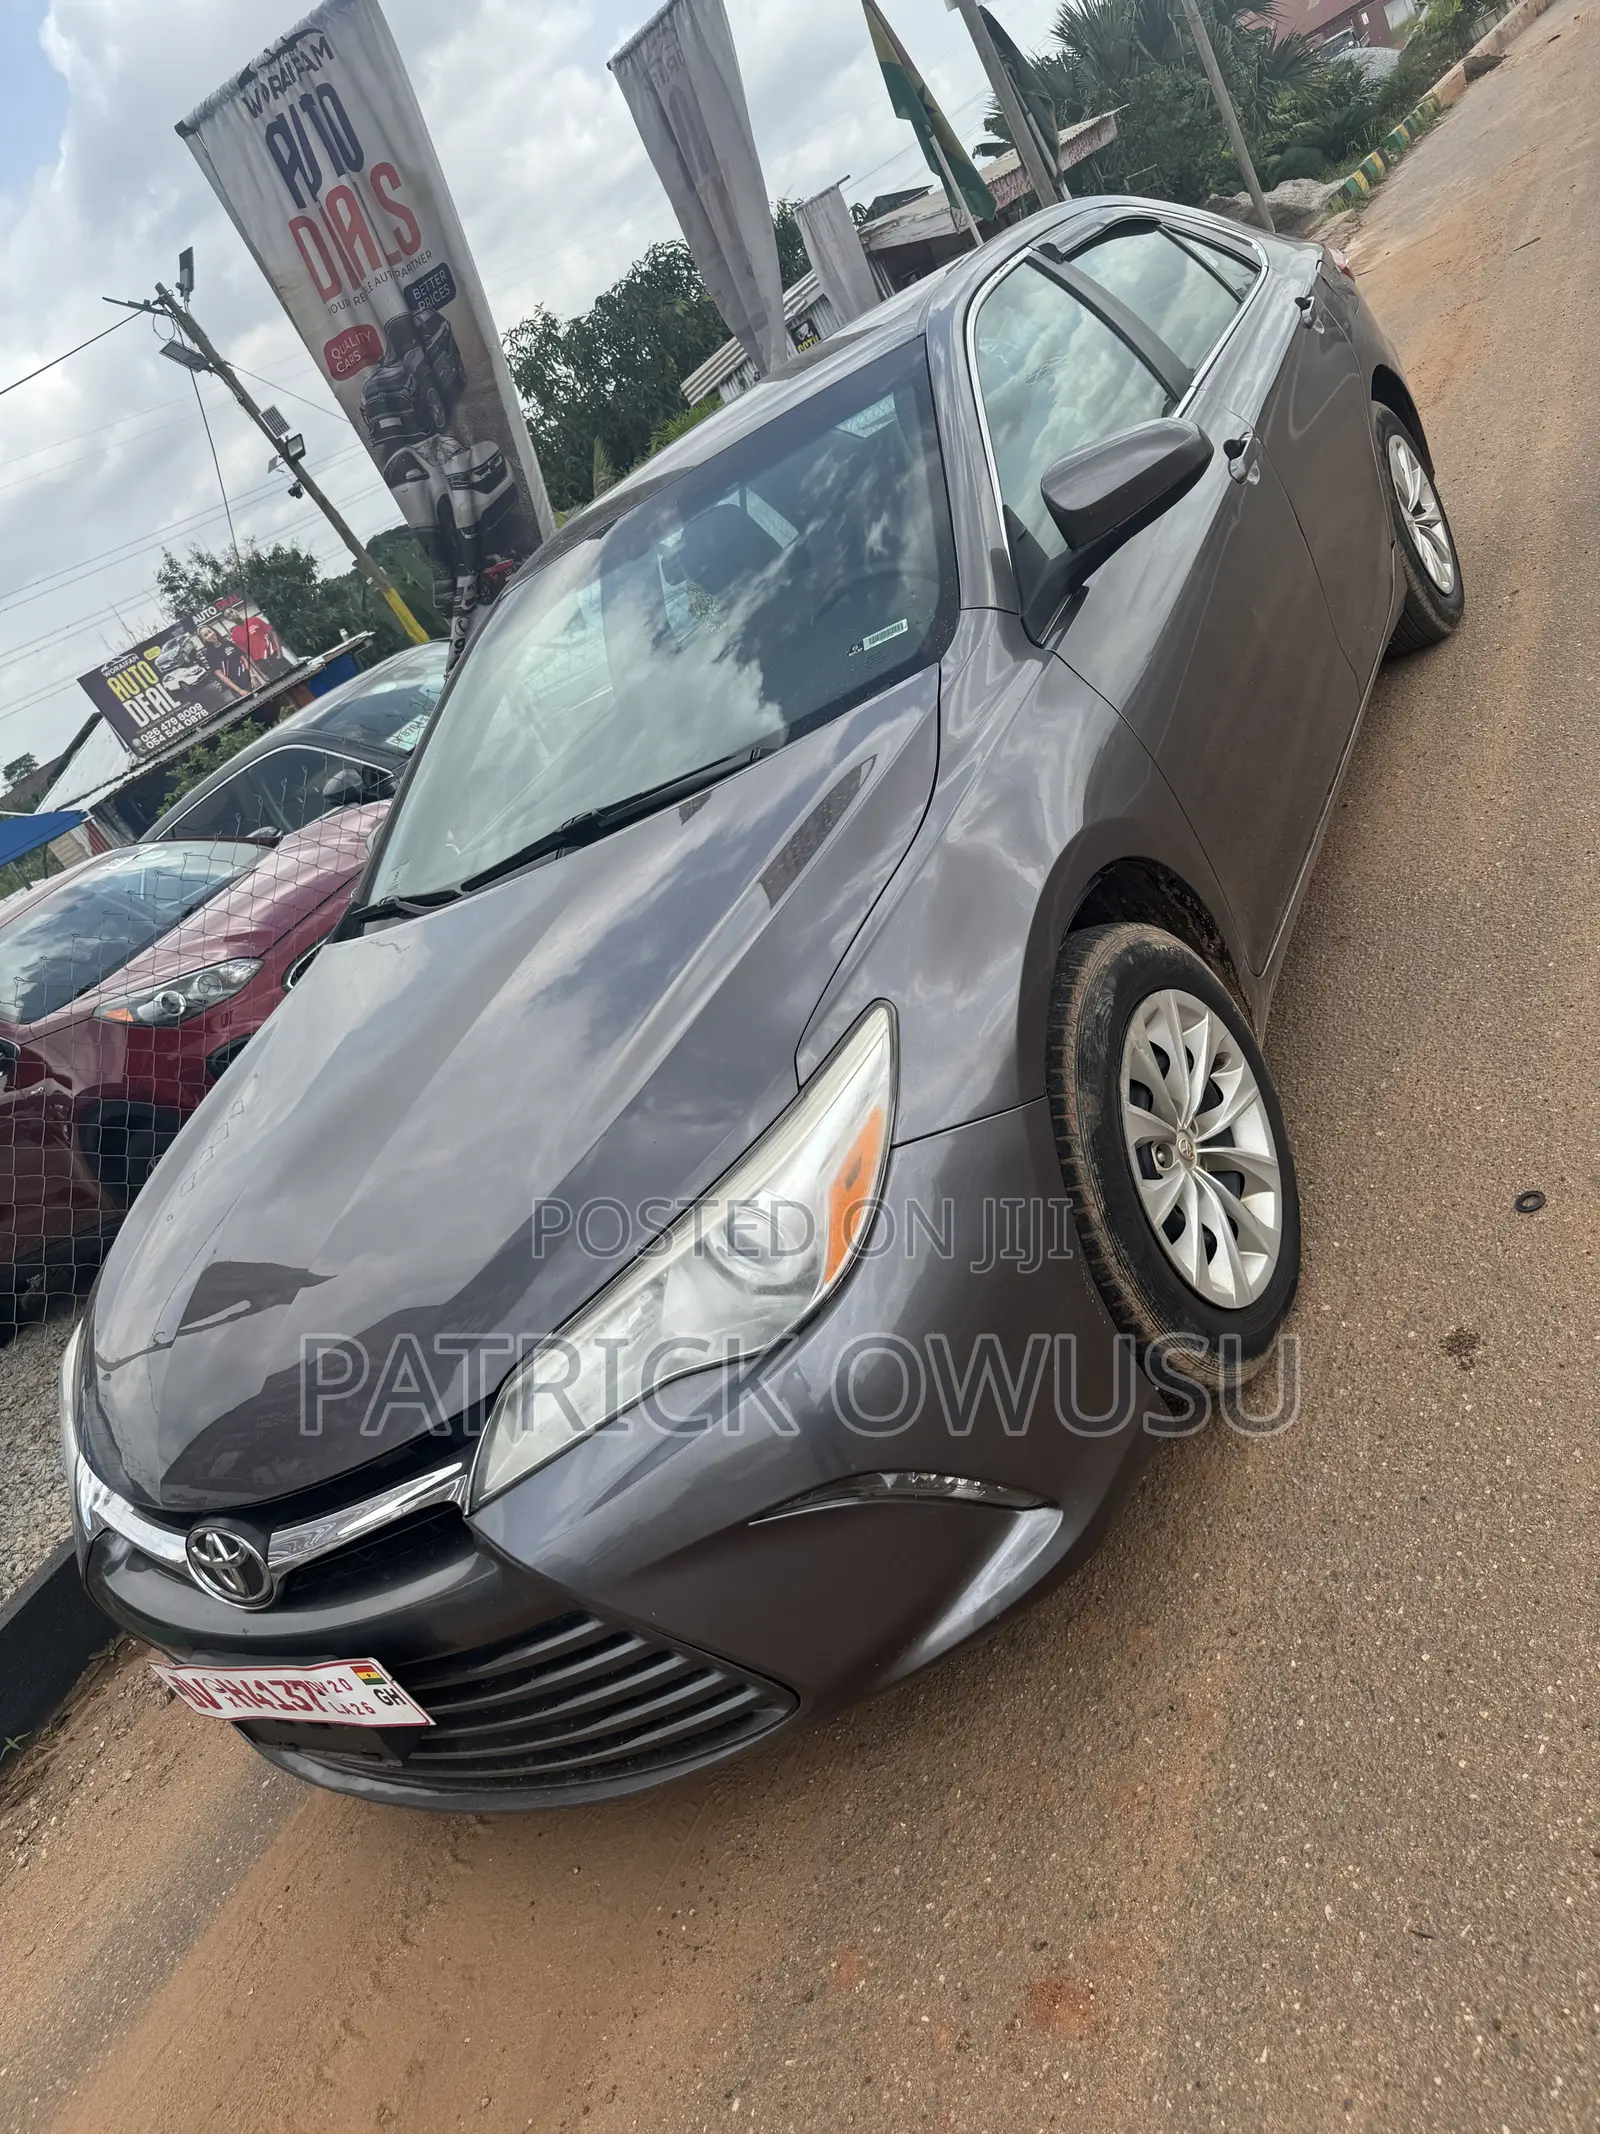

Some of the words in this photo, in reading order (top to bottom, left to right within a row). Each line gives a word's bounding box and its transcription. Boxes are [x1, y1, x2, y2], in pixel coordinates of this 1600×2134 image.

[265, 82, 365, 210] AUTO
[412, 269, 447, 300] BETTER
[418, 284, 451, 312] PRICES
[328, 299, 352, 316] YOUR
[331, 331, 372, 360] QUALITY
[336, 350, 362, 372] CARS
[192, 606, 218, 625] AUTO
[215, 594, 242, 611] DEAL
[107, 661, 160, 702] AUTO
[122, 683, 182, 728] DEAL
[141, 727, 161, 742] 026
[161, 717, 179, 731] 479
[177, 702, 203, 720] 8009
[146, 735, 166, 749] 054
[165, 725, 185, 738] 544
[184, 709, 209, 727] 0878
[373, 1688, 407, 1706] GH
